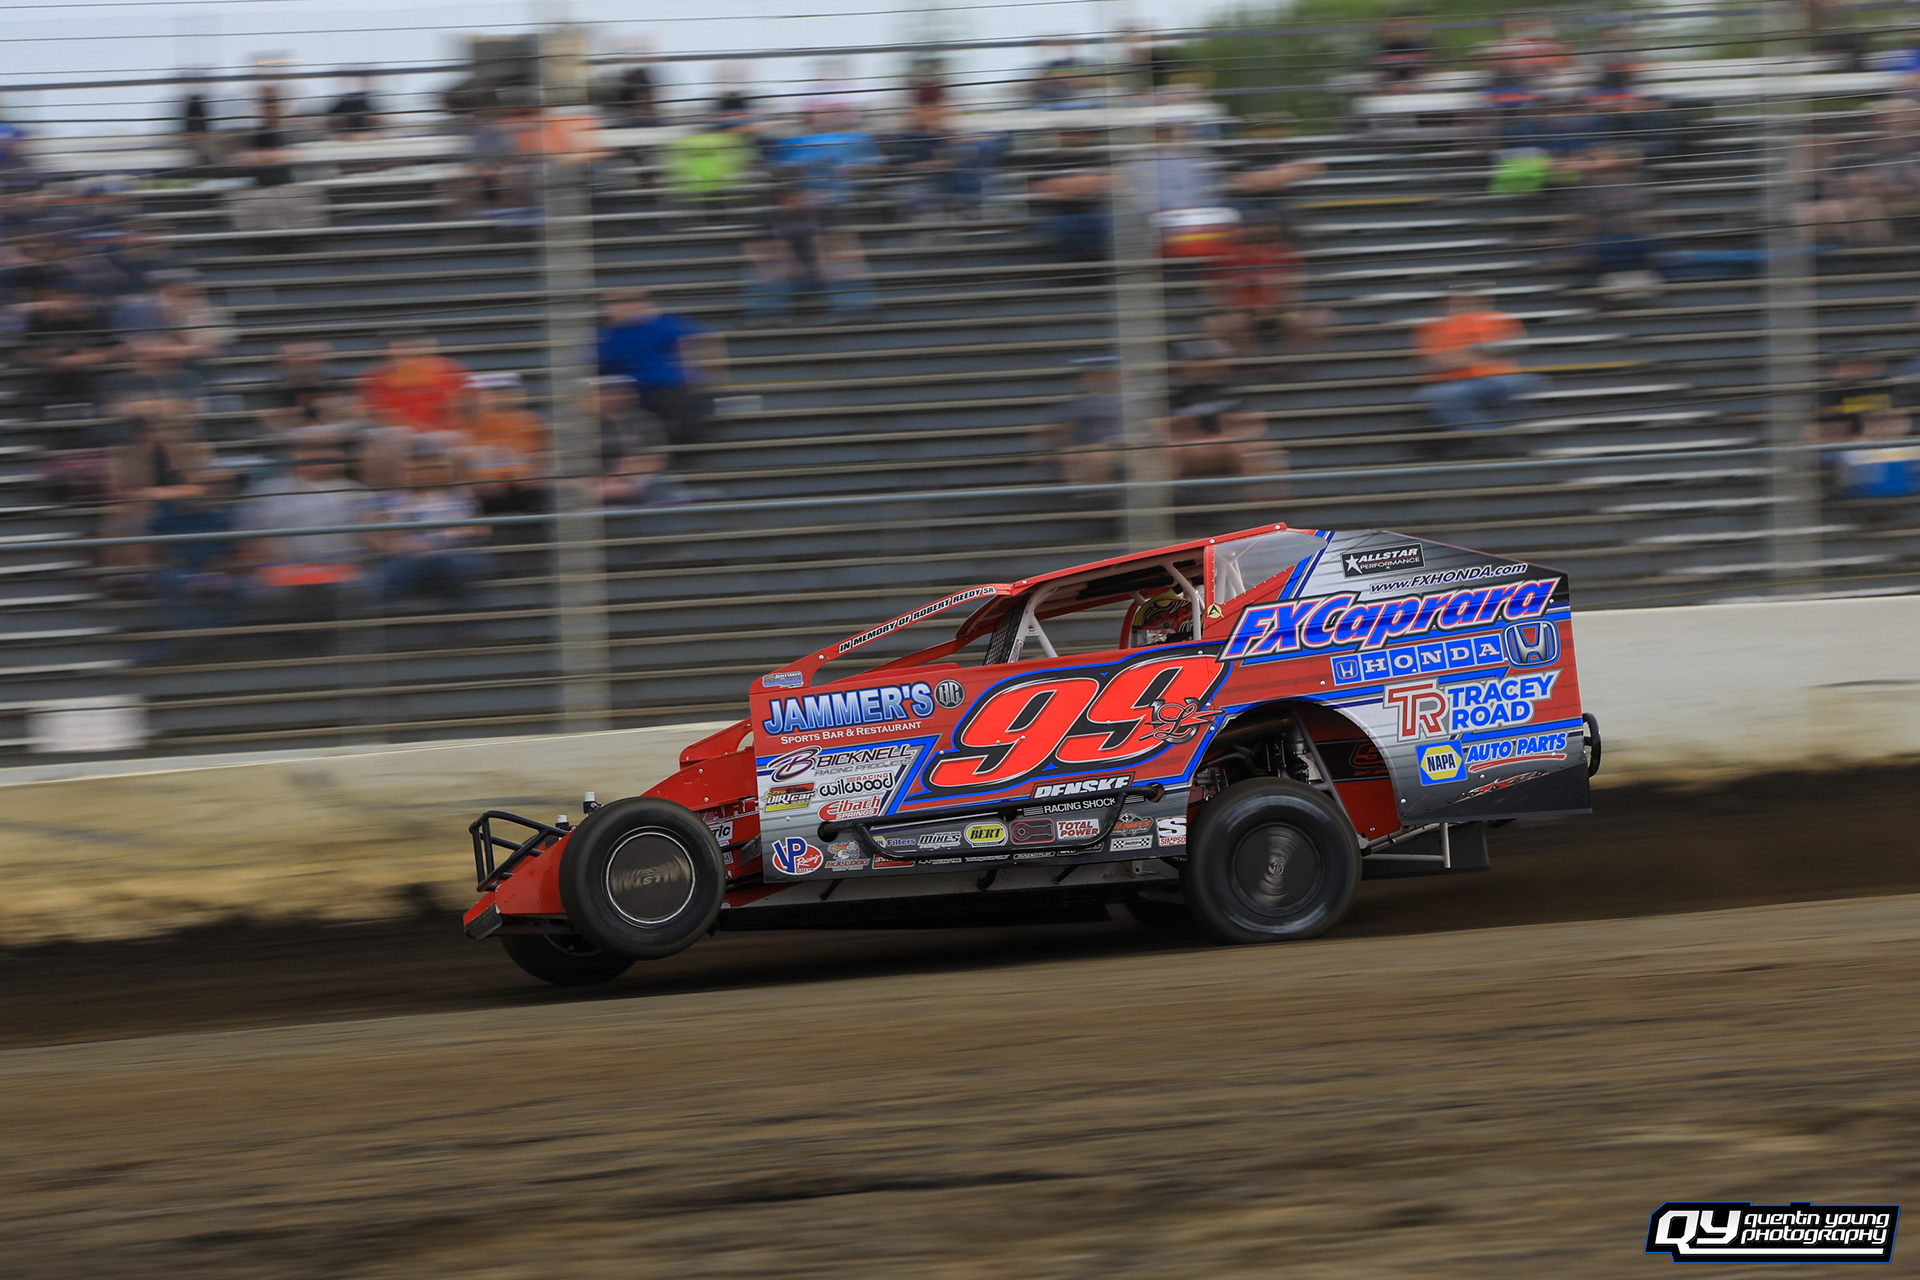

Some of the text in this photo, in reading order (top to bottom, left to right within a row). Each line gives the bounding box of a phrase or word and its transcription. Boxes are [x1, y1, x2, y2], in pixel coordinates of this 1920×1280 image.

[1357, 548, 1418, 563] ALLSTAR
[1360, 557, 1420, 570] PERFORMANCE
[1371, 563, 1528, 593] www.FXHONDA.com
[839, 640, 851, 653] IN
[853, 621, 896, 647] MEMORY
[898, 614, 912, 627] OF
[912, 598, 951, 621] ROBERT
[952, 588, 982, 605] REEDY
[1363, 642, 1501, 674] HONDA
[1450, 674, 1555, 708] TRACEY
[763, 682, 935, 734] JAMMER'S
[1452, 701, 1532, 731] ROAD
[929, 654, 1225, 787] 99
[781, 722, 922, 745] SPORTS BAR & RESTAURANT
[817, 746, 912, 768] BICKNELL
[1466, 733, 1568, 763] AUTO PARTS
[814, 766, 853, 777] RACING
[1427, 753, 1457, 773] NAPA
[819, 772, 894, 797] wilwood
[856, 773, 889, 782] RACING
[819, 796, 881, 821] Eibach
[836, 808, 875, 819] SPRINGS
[1044, 801, 1081, 814] RACING
[969, 828, 1003, 840] BERT
[1058, 821, 1093, 830] TOTAL
[1060, 828, 1099, 837] POWER
[887, 838, 916, 846] Filters
[773, 837, 807, 873] VP
